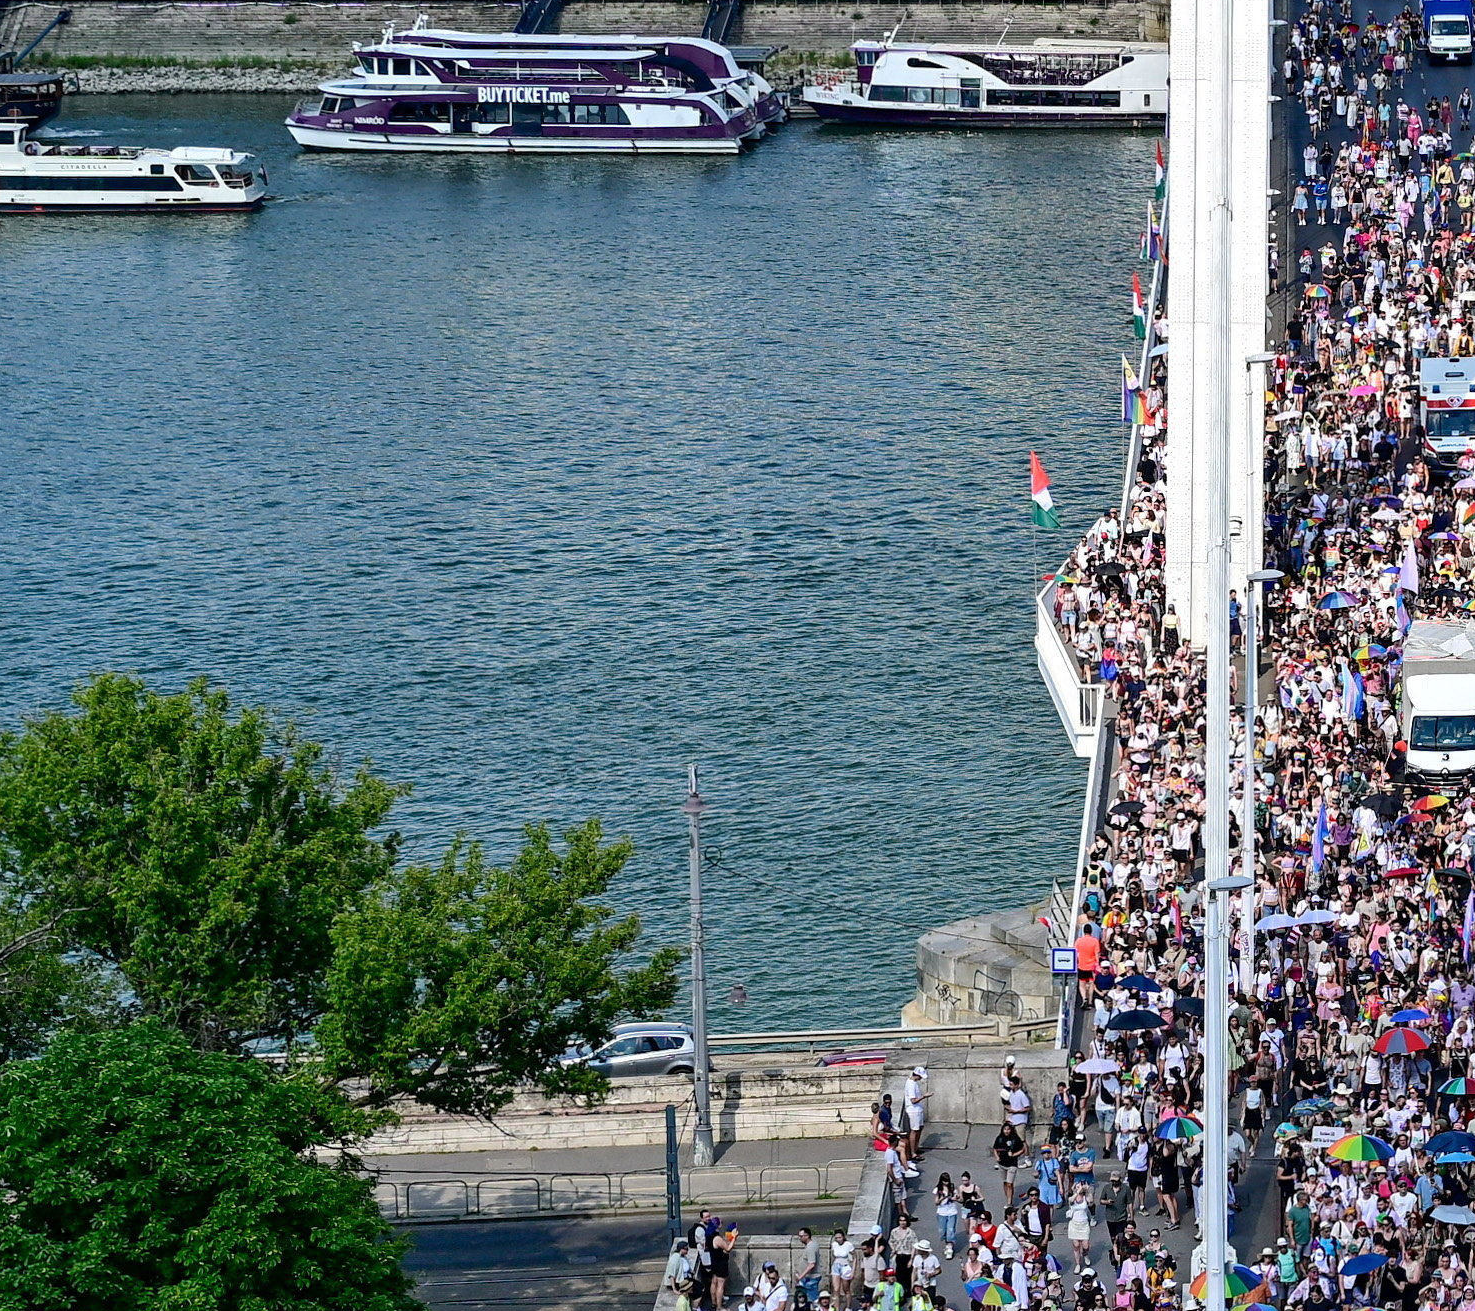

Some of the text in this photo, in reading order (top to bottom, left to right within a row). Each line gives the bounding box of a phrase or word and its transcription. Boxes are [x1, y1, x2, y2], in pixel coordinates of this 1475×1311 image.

[477, 86, 571, 104] BUYTICKET.me
[354, 115, 385, 125] NIMRÓD
[1442, 753, 1450, 761] 3
